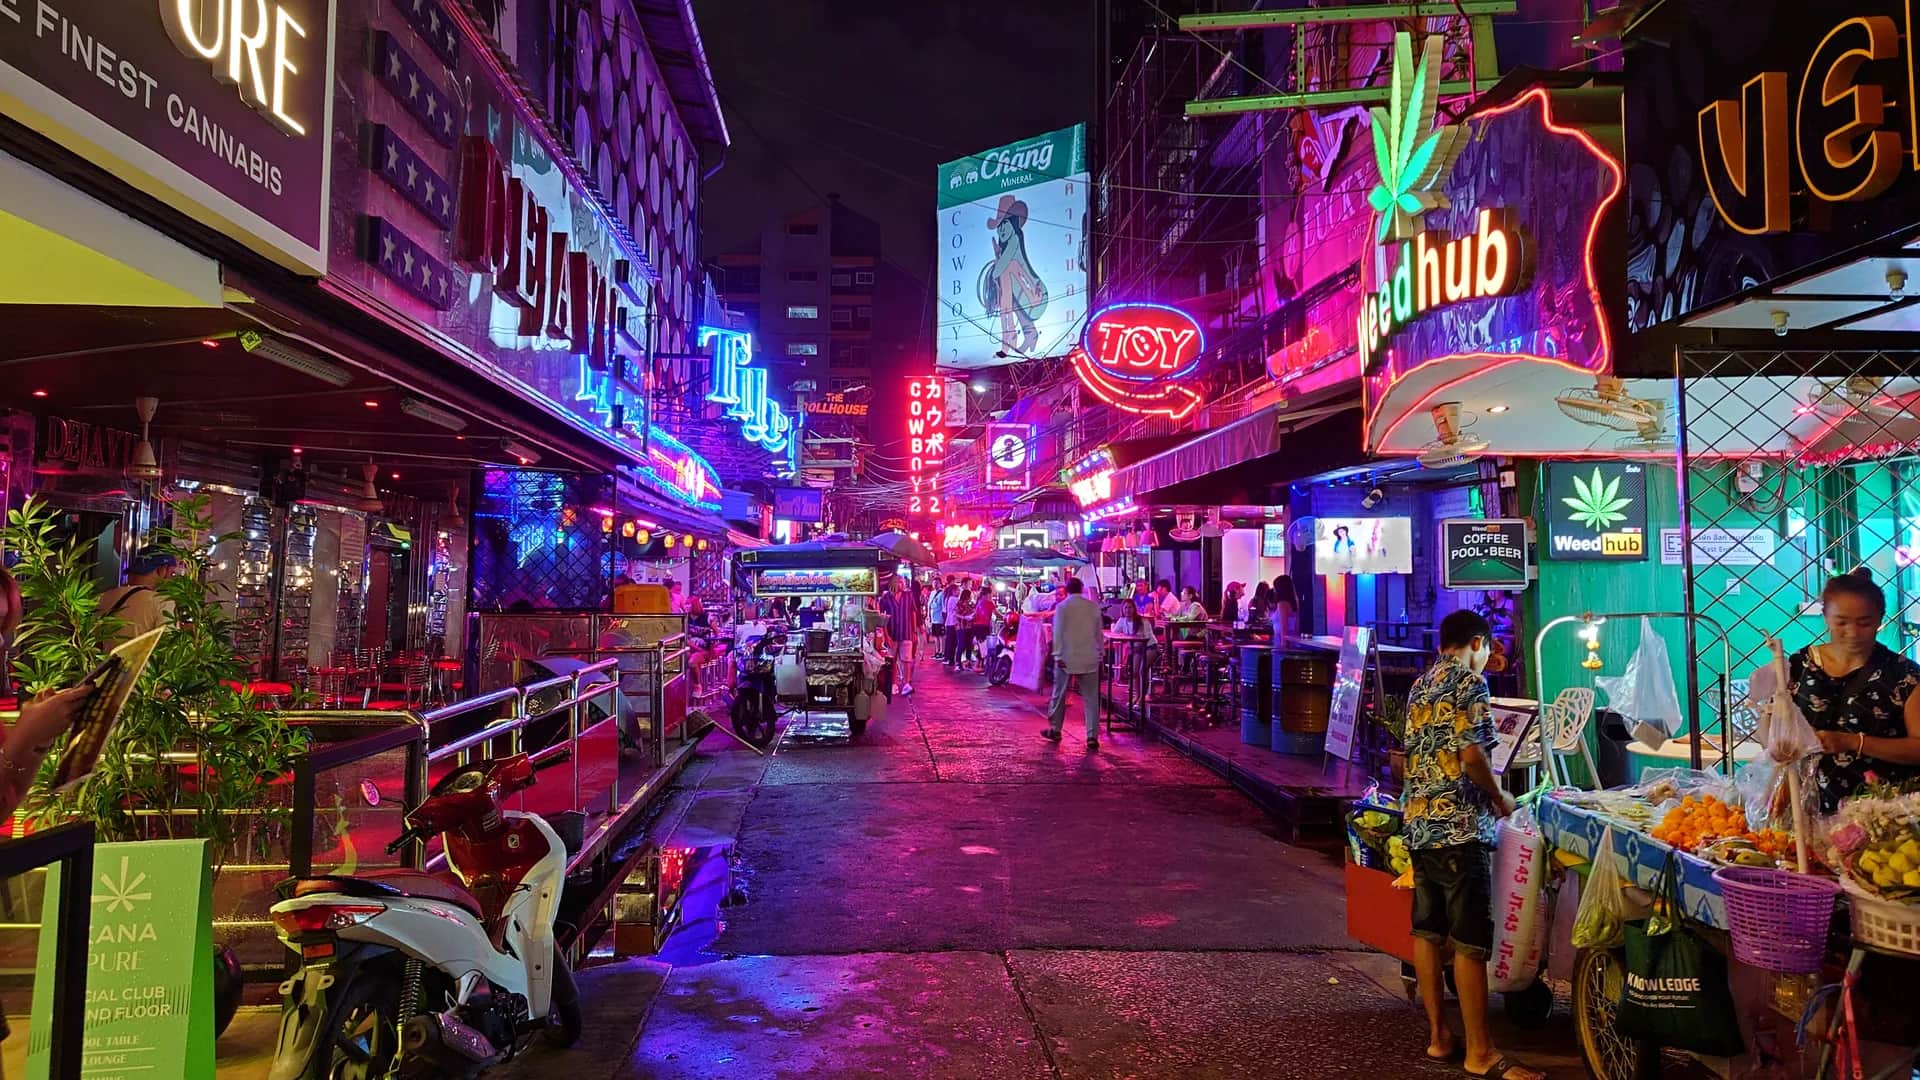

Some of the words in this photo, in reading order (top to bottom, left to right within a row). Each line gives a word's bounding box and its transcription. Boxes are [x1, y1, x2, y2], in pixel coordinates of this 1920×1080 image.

[36, 0, 158, 110] FINEST
[166, 94, 283, 196] CANNABIS
[980, 143, 1054, 179] Chang
[1303, 161, 1371, 249] LUCKY
[1098, 322, 1196, 368] TOY
[826, 393, 845, 402] THE
[1463, 533, 1509, 544] COFFEE
[1513, 844, 1534, 885] JT-45
[1504, 892, 1524, 932] JT-45
[1494, 939, 1514, 980] JT-45
[115, 1004, 171, 1018] FLOOR
[122, 986, 165, 1000] CLUB
